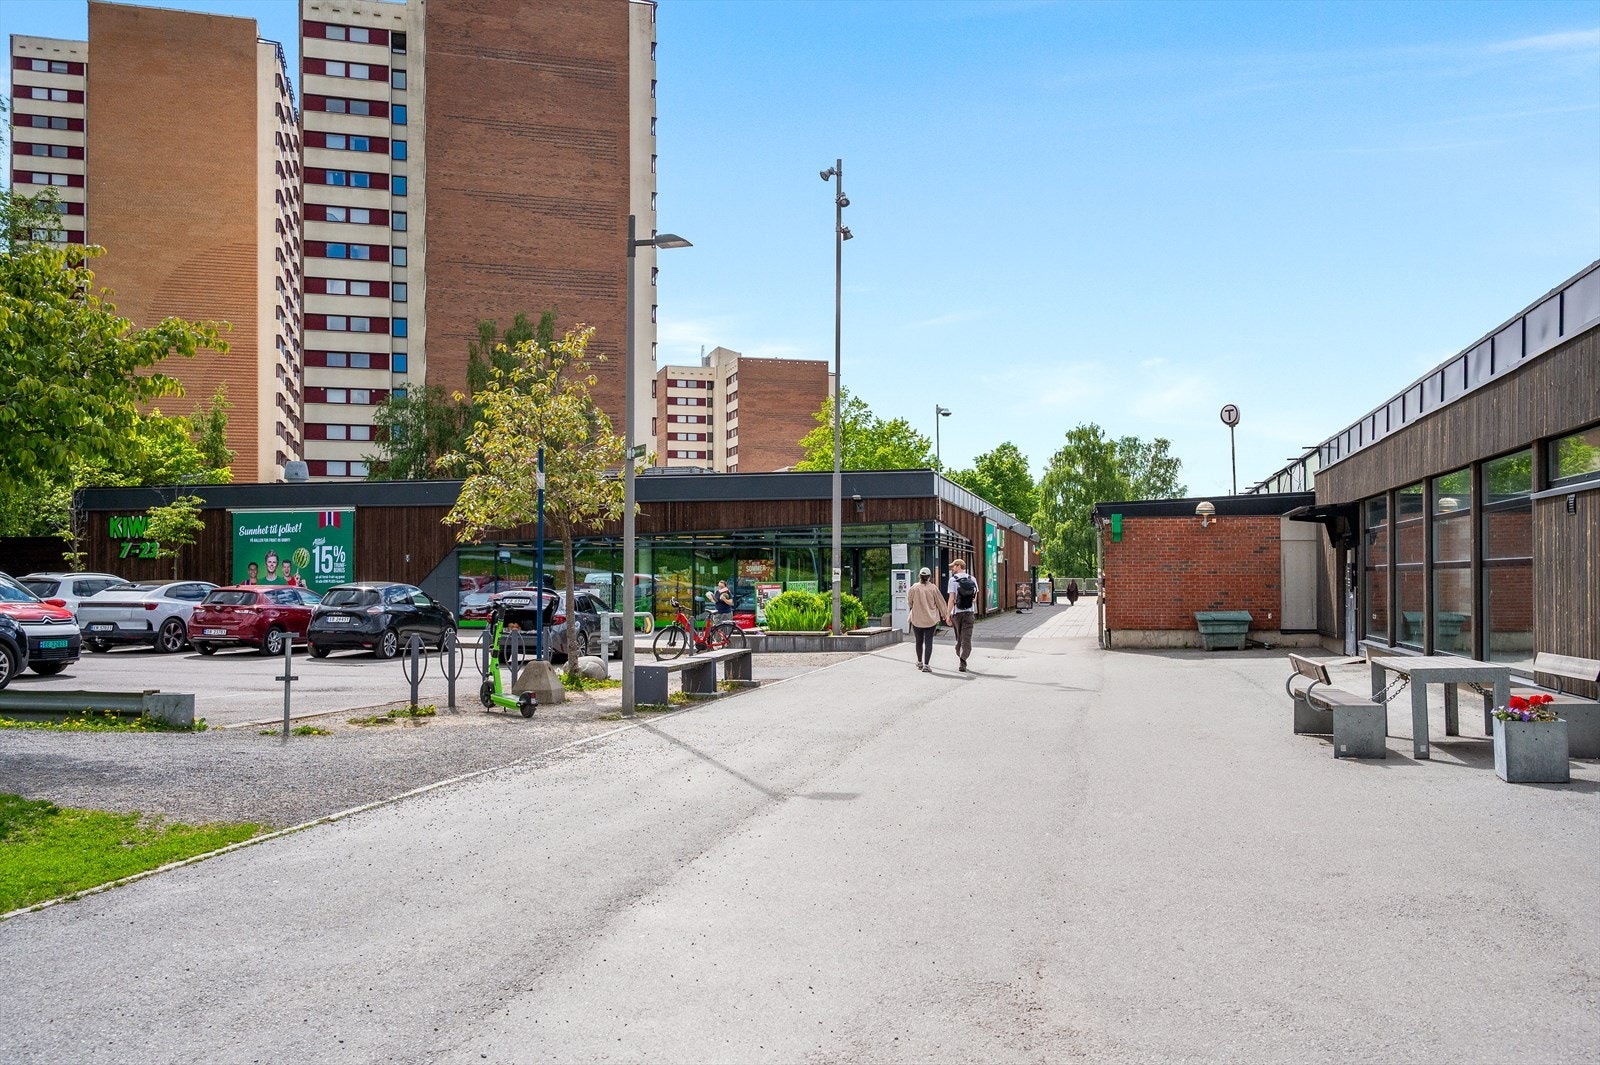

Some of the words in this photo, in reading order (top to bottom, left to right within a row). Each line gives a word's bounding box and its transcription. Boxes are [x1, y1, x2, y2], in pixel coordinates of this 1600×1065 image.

[1224, 409, 1234, 421] T
[238, 525, 269, 537] Sunnhet
[269, 523, 278, 534] til
[278, 522, 303, 537] folket!
